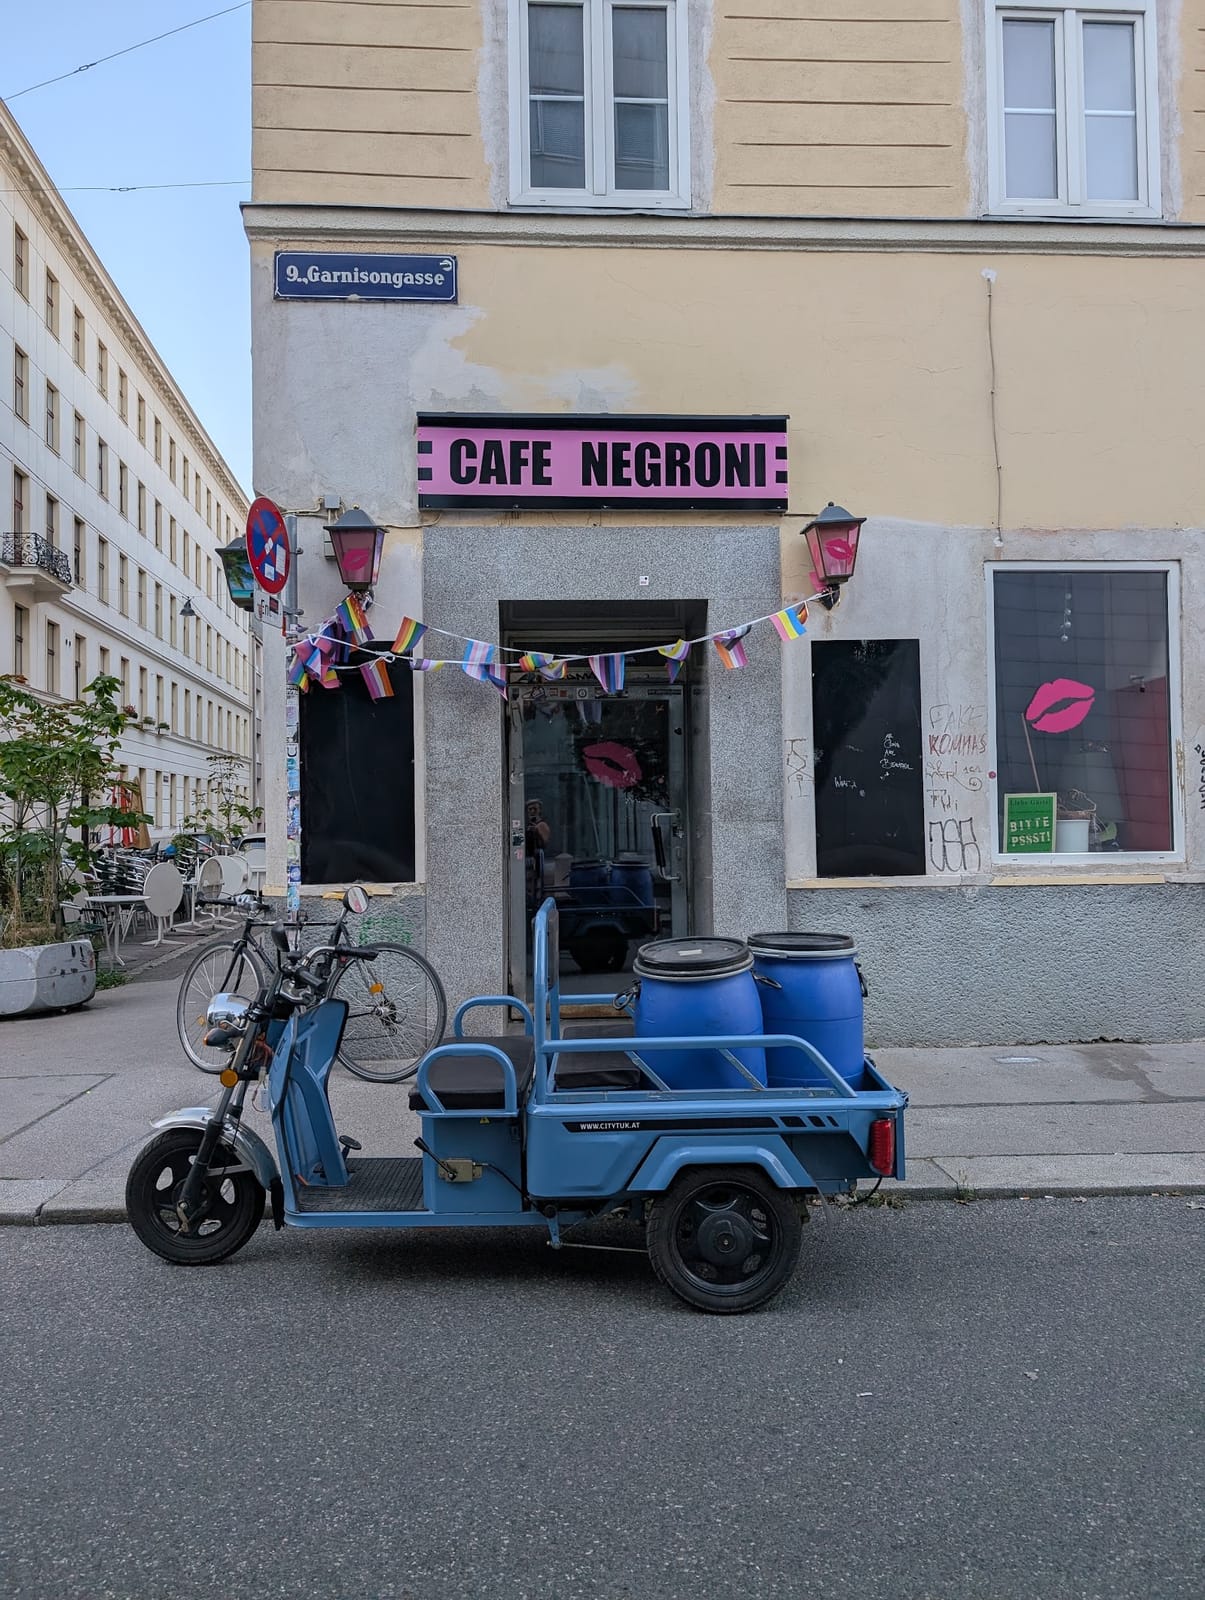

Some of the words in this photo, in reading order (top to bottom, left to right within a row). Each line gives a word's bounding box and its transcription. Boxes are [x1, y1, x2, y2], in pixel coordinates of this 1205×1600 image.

[450, 438, 553, 486] CAFE
[581, 441, 767, 488] NEGRONI
[1010, 816, 1050, 832] BITTE
[1011, 831, 1051, 847] PSSST!
[580, 1122, 640, 1130] WWW.CITYTUK.AT
